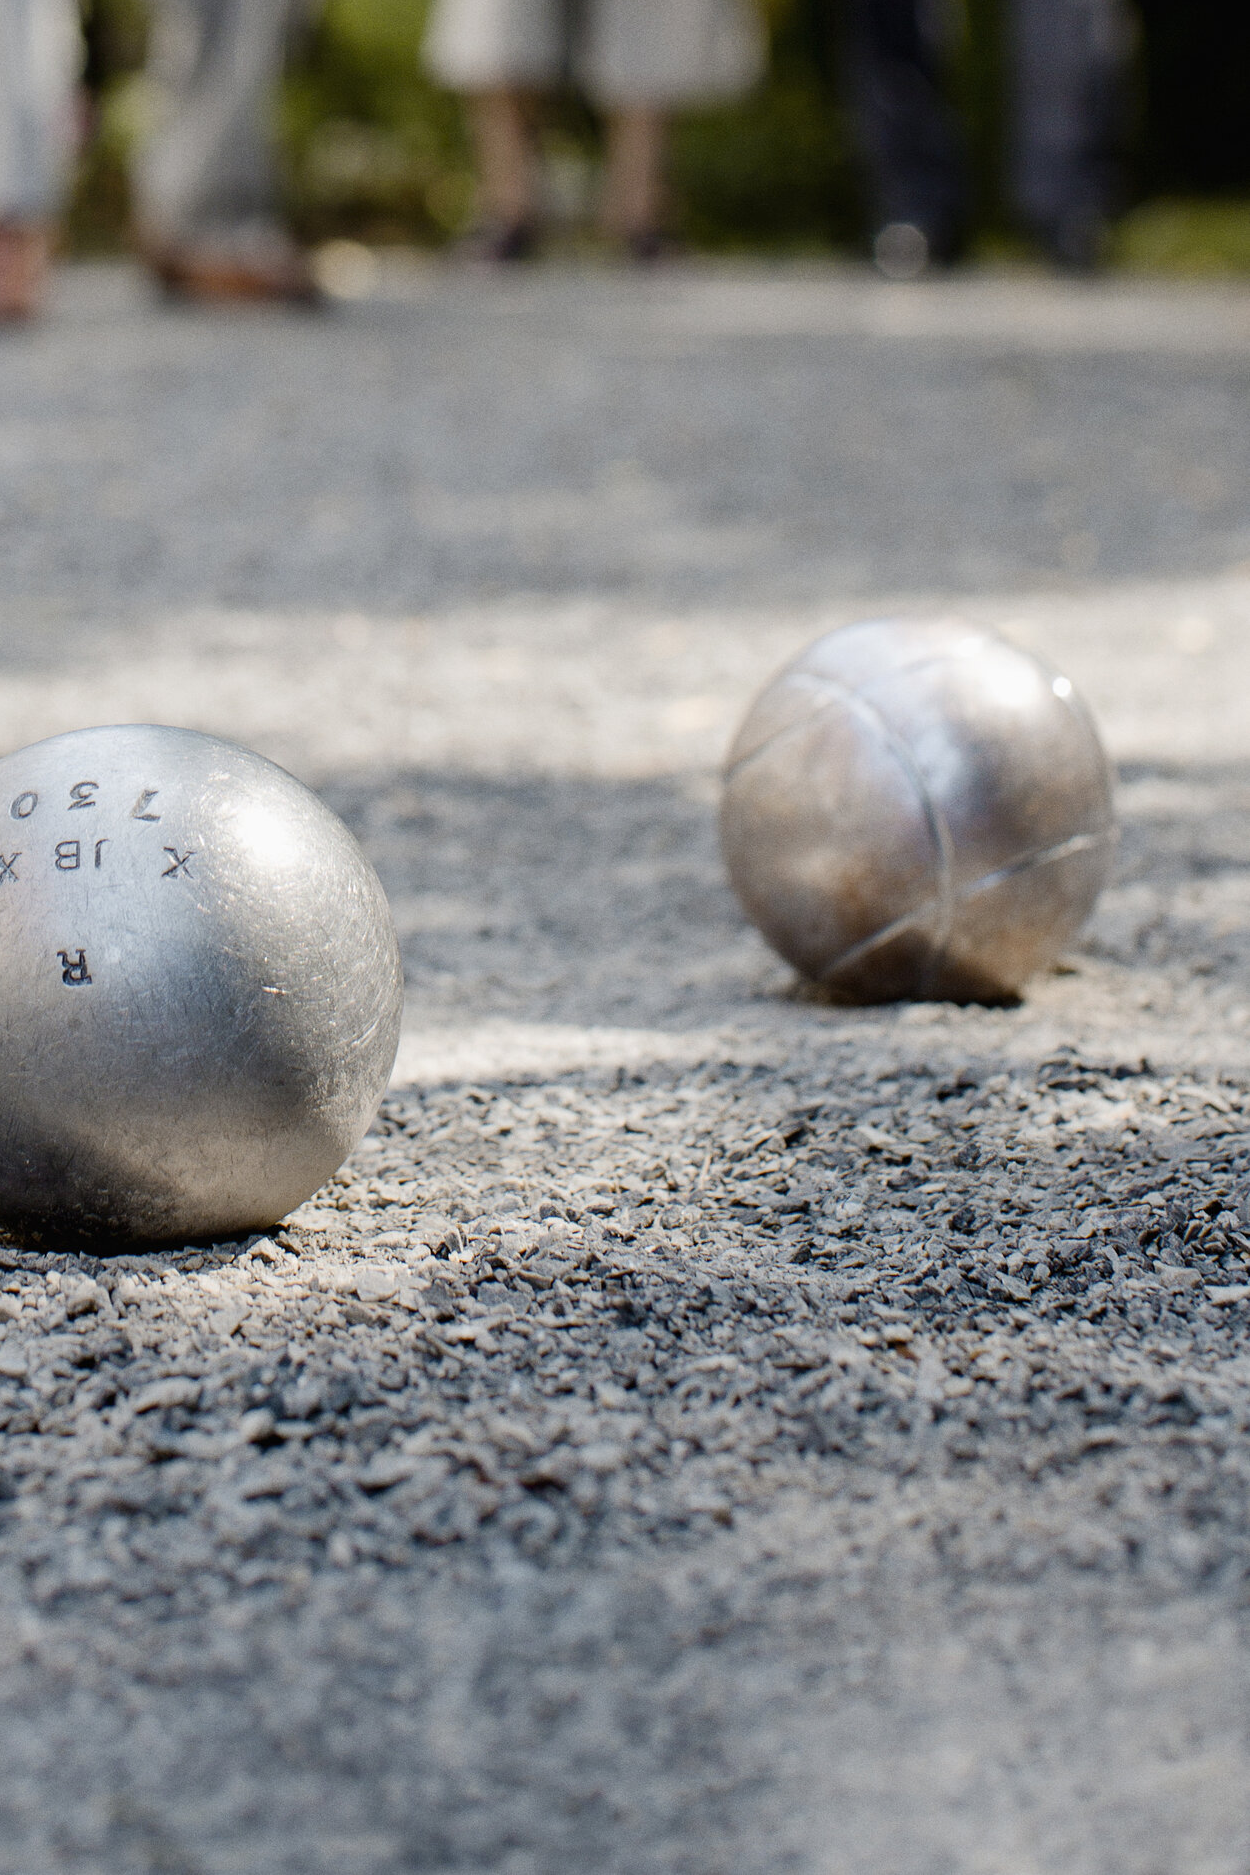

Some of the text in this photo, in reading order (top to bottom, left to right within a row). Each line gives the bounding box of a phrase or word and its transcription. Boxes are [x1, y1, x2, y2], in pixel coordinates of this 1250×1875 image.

[55, 838, 110, 871] JB
[161, 846, 196, 880] X
[56, 949, 93, 987] R
